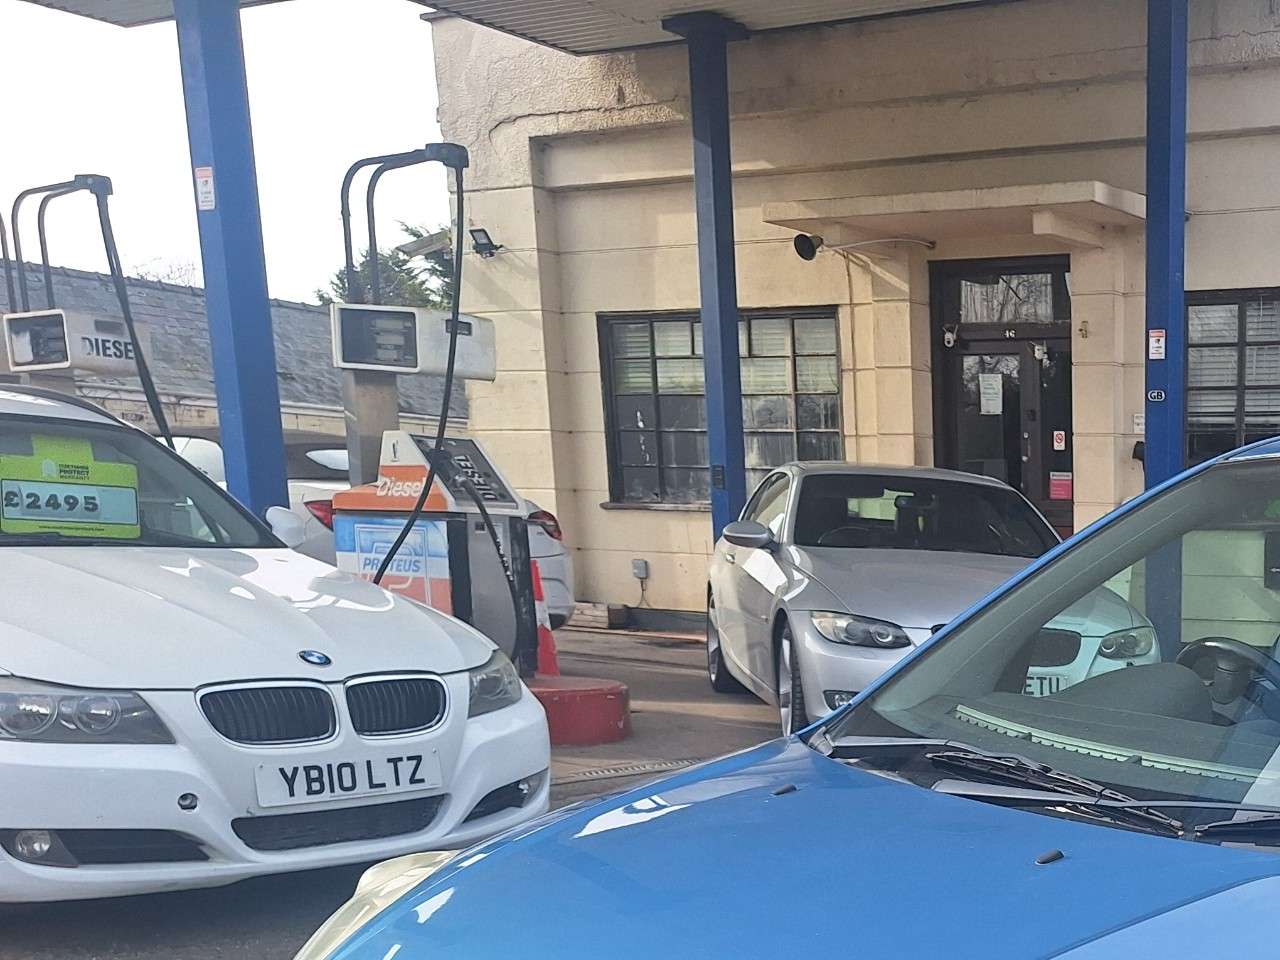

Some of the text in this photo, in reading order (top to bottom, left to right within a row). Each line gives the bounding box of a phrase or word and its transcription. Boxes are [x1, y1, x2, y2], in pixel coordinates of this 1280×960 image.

[81, 336, 136, 360] DIESE
[1149, 391, 1163, 400] GB
[4, 491, 98, 512] £2495
[363, 557, 421, 573] PRTEUS
[278, 755, 425, 797] YB10 LTZ
